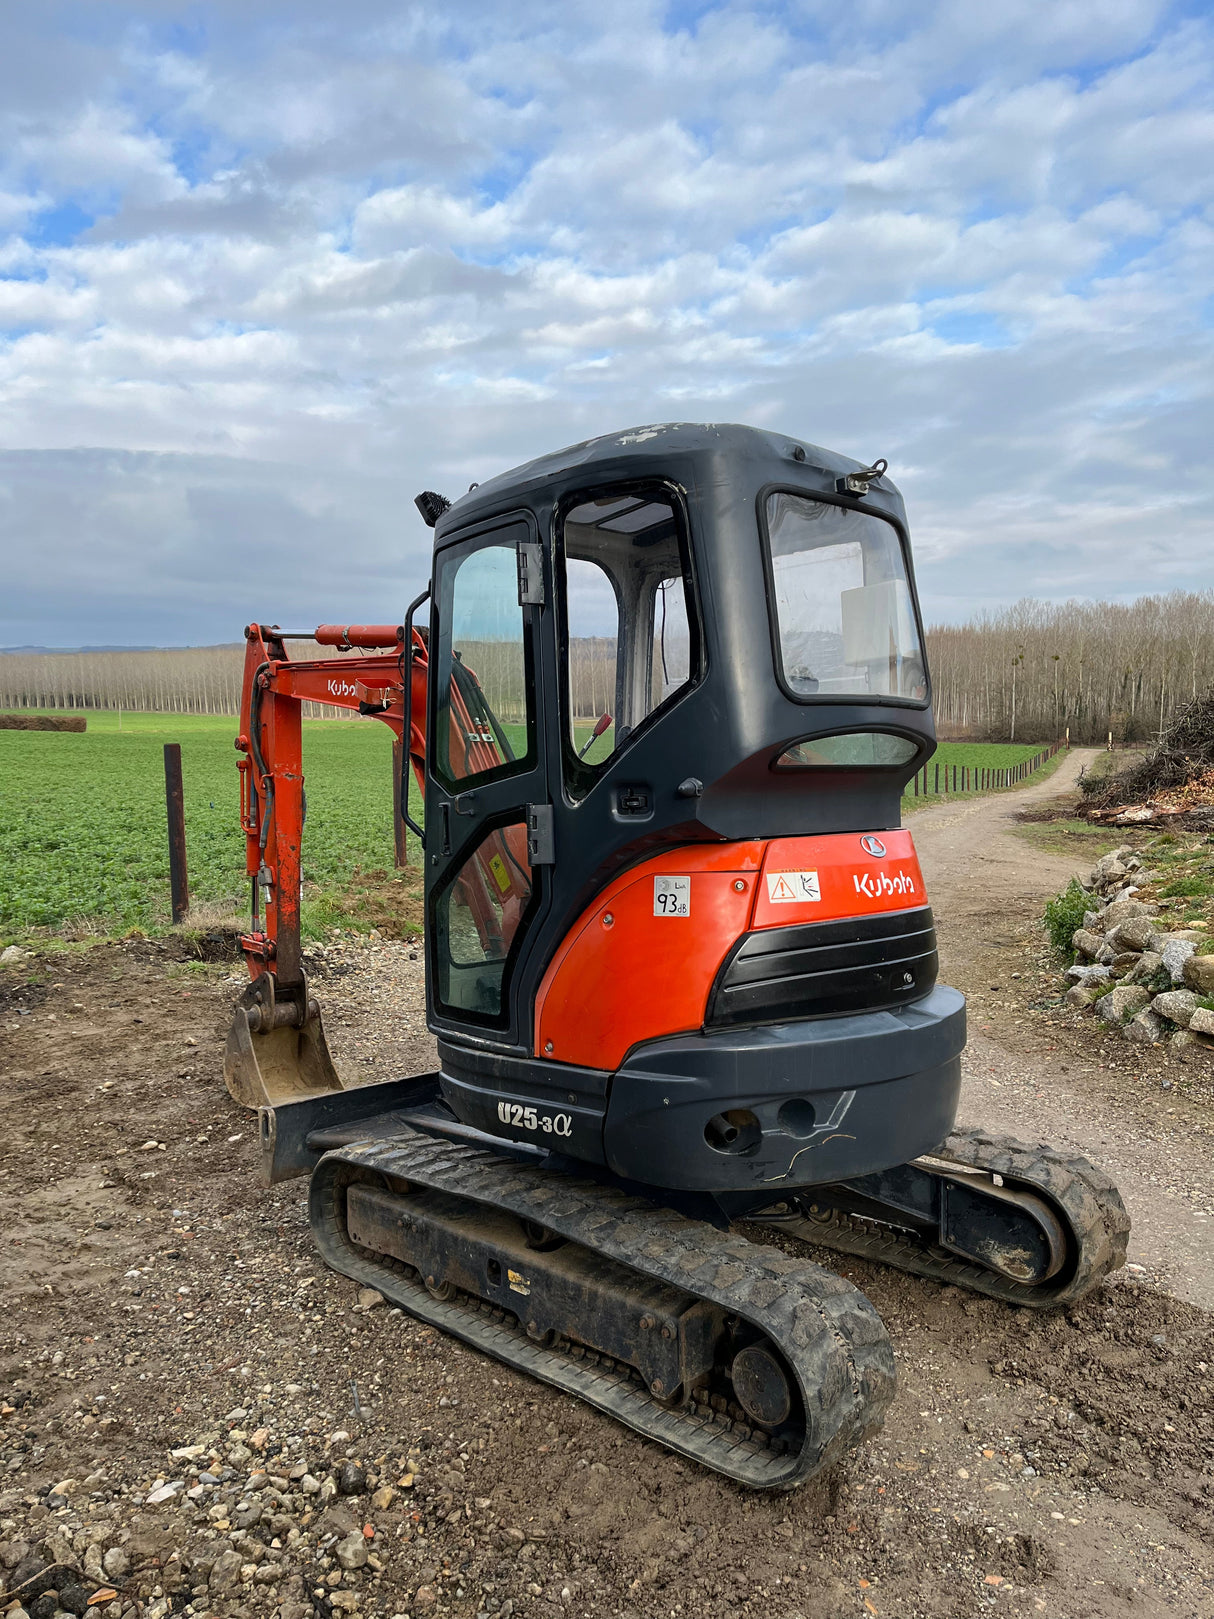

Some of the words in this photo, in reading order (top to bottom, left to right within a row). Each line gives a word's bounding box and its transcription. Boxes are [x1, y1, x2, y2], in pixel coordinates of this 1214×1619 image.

[327, 679, 356, 696] Kubo
[853, 870, 915, 898] Kubota
[657, 893, 678, 913] 93
[677, 903, 687, 914] dB
